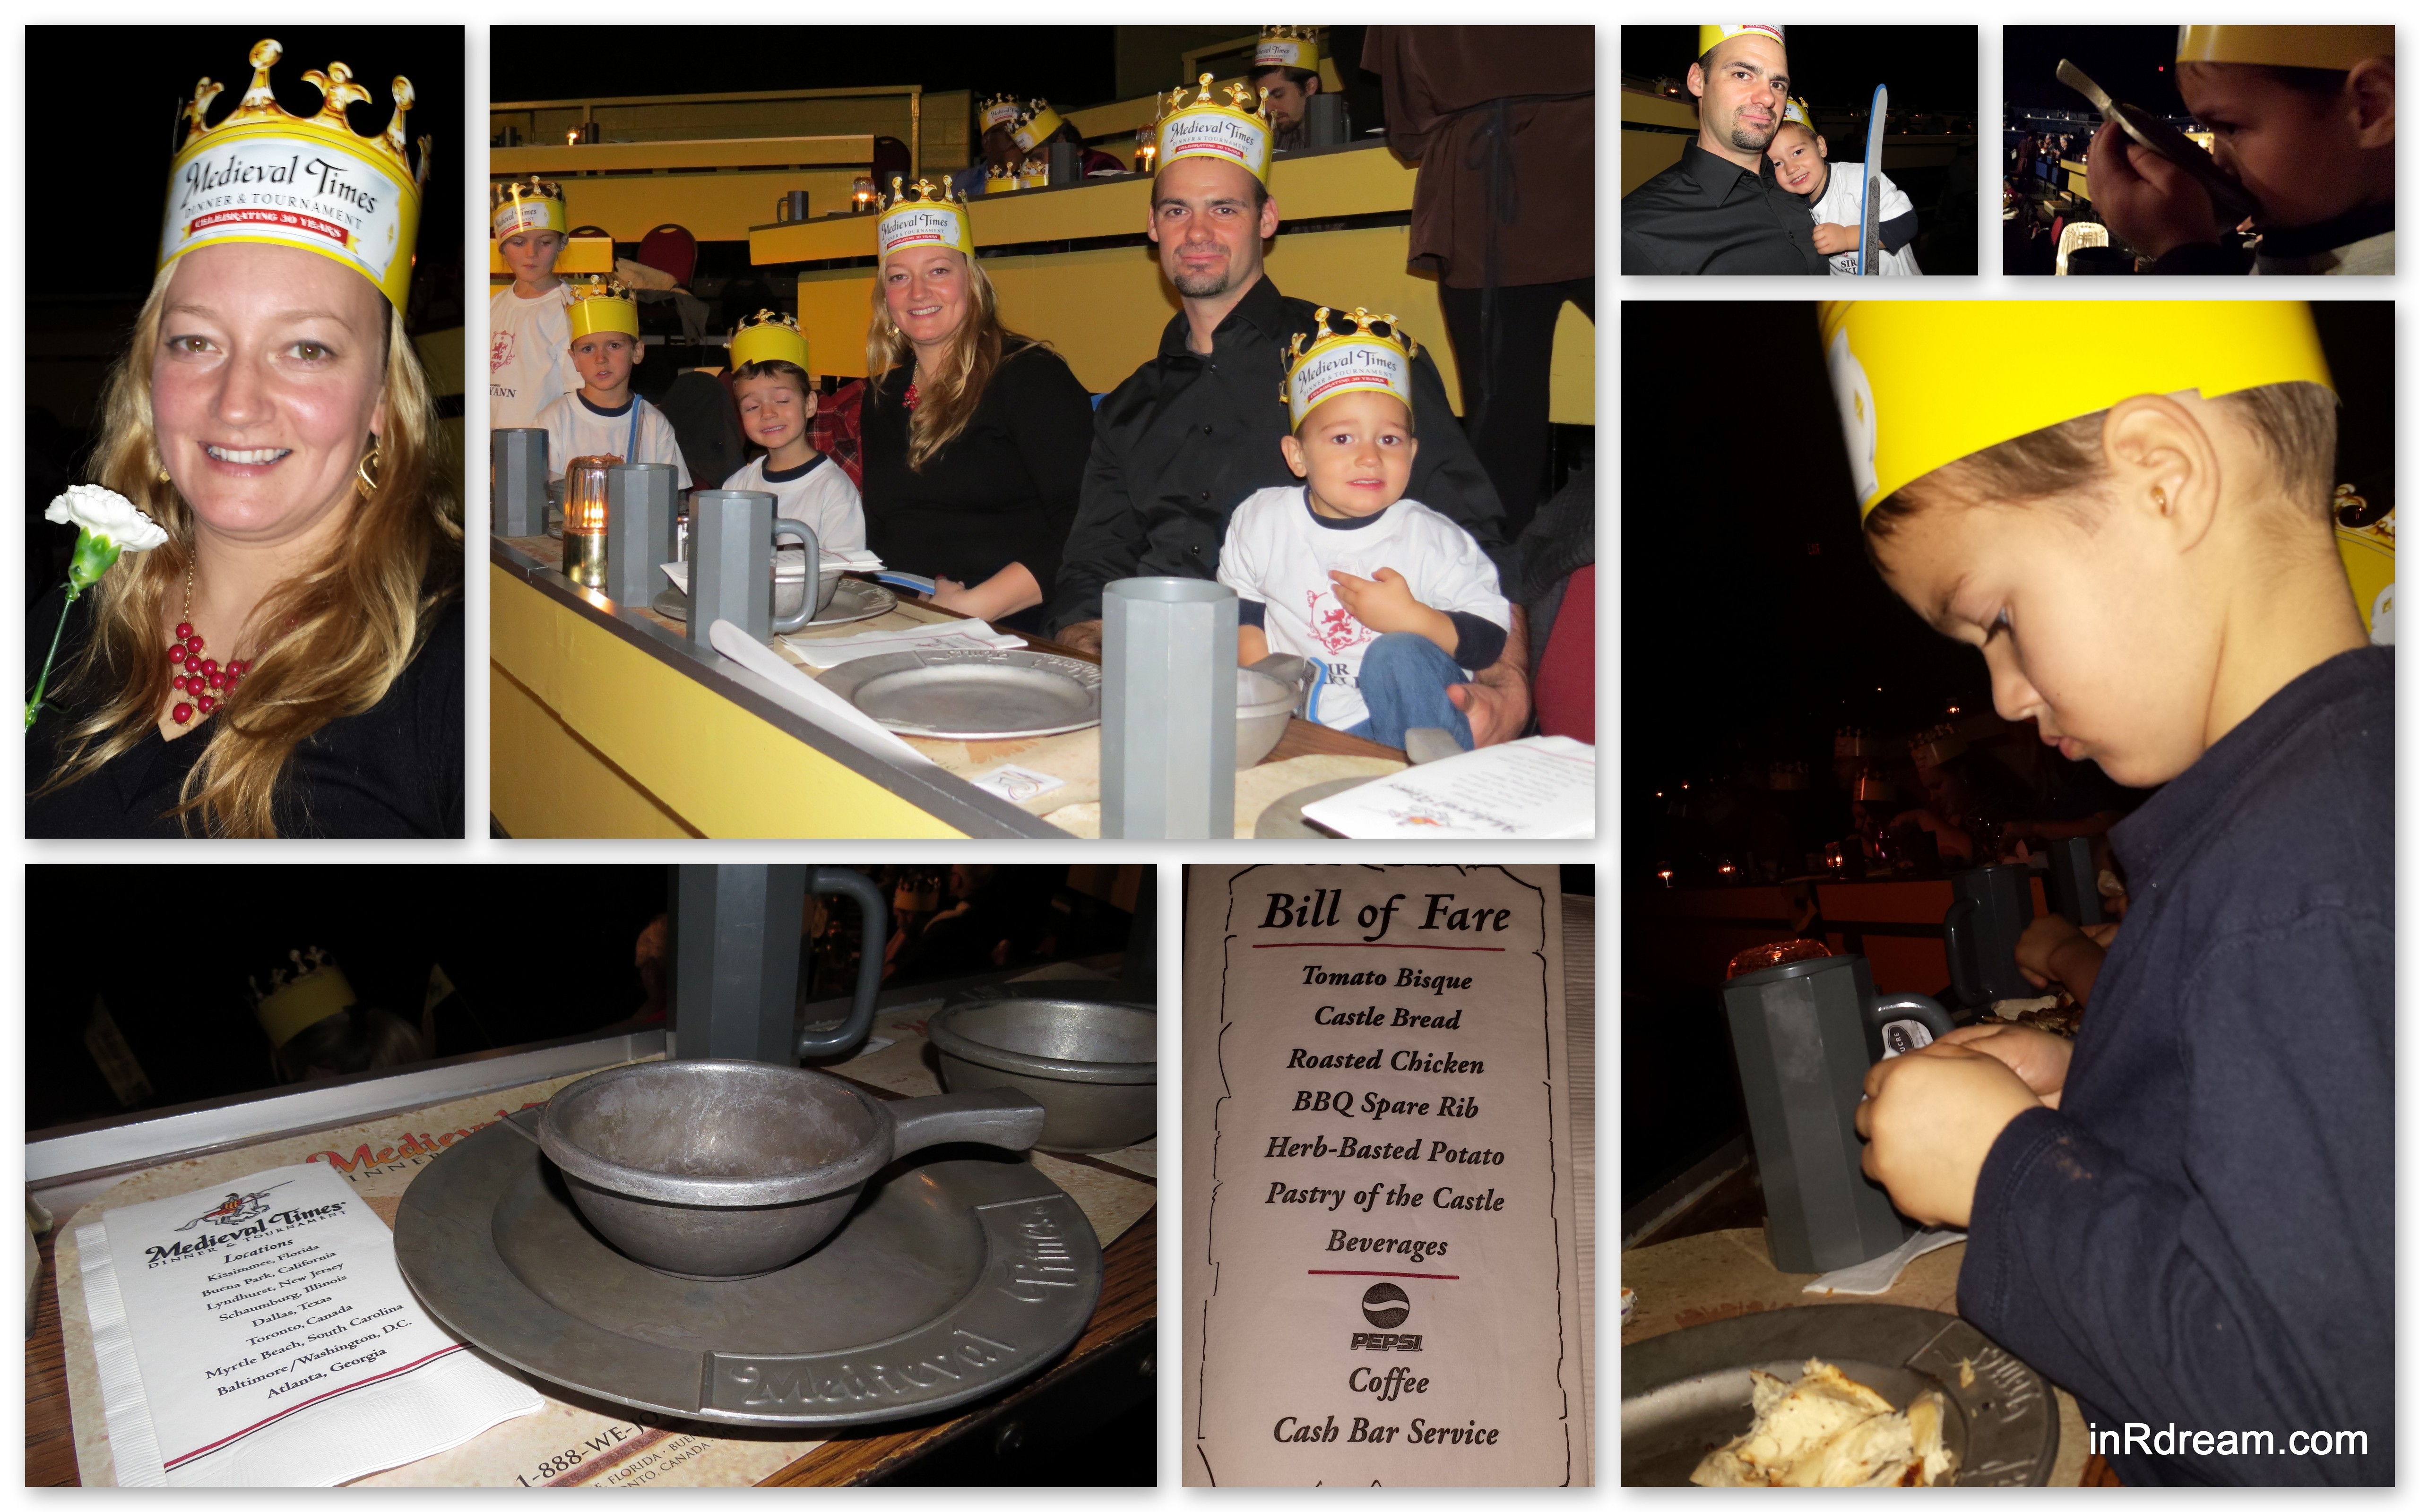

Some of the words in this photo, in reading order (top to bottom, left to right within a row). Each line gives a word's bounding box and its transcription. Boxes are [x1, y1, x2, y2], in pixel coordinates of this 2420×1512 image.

[1272, 46, 1290, 54] Times
[991, 107, 1010, 118] Medieval
[1170, 120, 1223, 143] Medieval
[1225, 122, 1254, 145] Times
[1172, 137, 1195, 146] DINNER
[1203, 136, 1248, 152] TOURNAMENT
[1225, 146, 1241, 156] YEARS
[180, 154, 299, 209] Medieval
[304, 157, 380, 214] Times
[184, 194, 232, 219] DINNER
[236, 193, 247, 204] &
[251, 193, 363, 230] TOURNAMENT
[194, 211, 278, 229] CELEBRATING
[280, 214, 298, 225] 30
[300, 217, 342, 238] YEARS
[882, 215, 917, 241] Medieval
[919, 214, 948, 228] Times
[884, 234, 899, 244] DINNER
[888, 236, 915, 248] CELEBRATING
[1841, 259, 1858, 268] SIR
[1298, 351, 1353, 394] Medieval
[1357, 350, 1398, 371] Times
[1303, 378, 1325, 397] DINNER
[1334, 369, 1393, 378] TOURNAMENT
[1310, 378, 1350, 398] CELEBRATING
[1327, 663, 1350, 675] IR
[1258, 889, 1343, 929] Bill
[1357, 894, 1406, 942] of
[1418, 893, 1511, 932] Fare
[1302, 965, 1387, 987] Tomato
[1394, 968, 1473, 996] Bisque
[1314, 1005, 1385, 1028] Castle
[1390, 1008, 1462, 1030] Bread
[1893, 1032, 1906, 1053] UCRE
[1287, 1048, 1382, 1070] Roasted
[1390, 1049, 1485, 1074] Chicken
[1292, 1091, 1355, 1116] BBQ
[1361, 1092, 1430, 1120] Spare
[1436, 1096, 1479, 1119] Rib
[1264, 1135, 1421, 1161] Herb-Basted
[1427, 1141, 1505, 1166] Potato
[348, 1153, 440, 1183] INNE
[1265, 1182, 1346, 1211] Pastry
[1354, 1183, 1384, 1212] of
[1385, 1185, 1423, 1208] the
[1433, 1186, 1505, 1212] Castle
[145, 1219, 268, 1263] Medieval
[268, 1203, 343, 1225] Times
[147, 1247, 218, 1269] DINNER
[242, 1210, 347, 1242] TOURNAMENT
[1325, 1228, 1448, 1263] Beverages
[207, 1260, 276, 1282] Kissimmee,
[277, 1245, 320, 1261] Florida
[224, 1239, 294, 1264] Locations
[201, 1283, 242, 1297] Buena
[243, 1272, 276, 1285] Park,
[278, 1251, 337, 1273] California
[206, 1287, 277, 1310] Lyndhurst,
[277, 1275, 307, 1289] New
[309, 1263, 344, 1279] Jersey
[219, 1292, 302, 1322] Schaumburg,
[303, 1275, 347, 1293] Illinois
[251, 1310, 297, 1327] Dallas,
[297, 1295, 333, 1311] Texas
[731, 1323, 1016, 1405] Medieval
[997, 1215, 1078, 1303] Times
[246, 1323, 305, 1346] Toronto,
[306, 1304, 354, 1325] Canada
[205, 1357, 257, 1379] Myrtle
[260, 1340, 305, 1361] Beach,
[307, 1324, 347, 1342] South
[349, 1304, 404, 1326] Carolina
[1350, 1333, 1423, 1352] PEPSI
[216, 1332, 381, 1397] Baltimore/Washington,
[381, 1319, 413, 1334] D.C.
[267, 1372, 327, 1399] Atlanta,
[329, 1348, 387, 1372] Georgia
[1348, 1366, 1430, 1402] Coffee
[1273, 1416, 1340, 1444] Cash
[1347, 1418, 1400, 1444] Bar
[1407, 1419, 1500, 1446] Service
[607, 1452, 662, 1485] FLORIDA
[660, 1441, 710, 1471] CANADA
